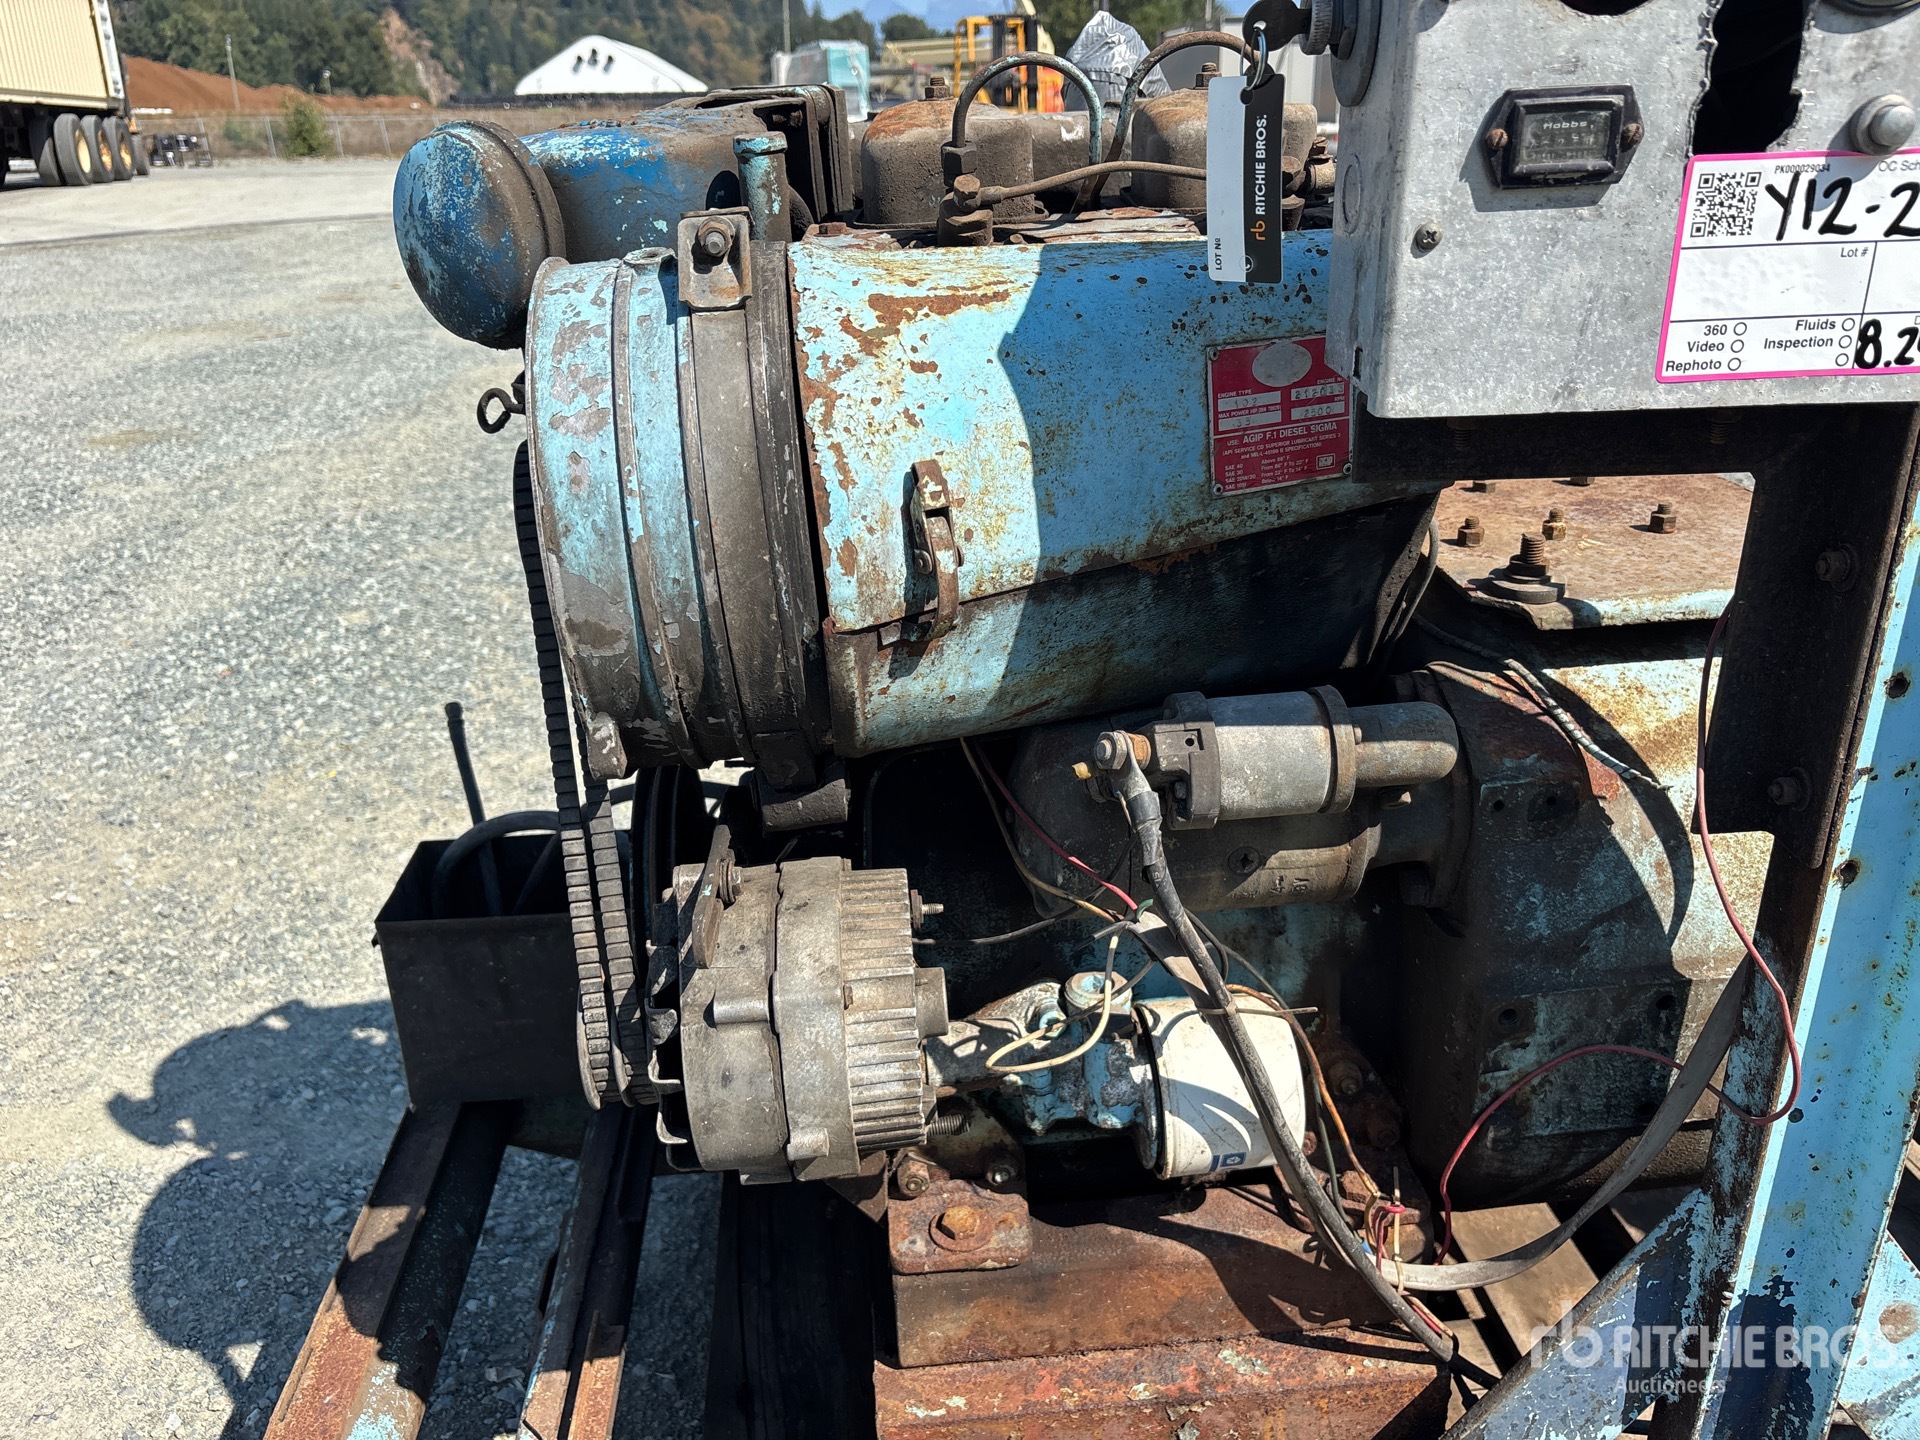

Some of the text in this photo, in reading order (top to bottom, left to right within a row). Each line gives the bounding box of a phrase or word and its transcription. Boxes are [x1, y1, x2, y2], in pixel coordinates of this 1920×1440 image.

[1543, 120, 1587, 130] Hobbs
[1878, 160, 1898, 173] OC
[1250, 114, 1267, 241] rb RITCHIE BROS.
[1840, 247, 1869, 258] Lot #
[1703, 324, 1728, 336] 360
[1795, 318, 1836, 332] Fluids
[1687, 341, 1725, 353] Video
[1764, 337, 1834, 351] Inspection
[1665, 358, 1722, 373] Rephoto
[1242, 433, 1264, 444] AGIP
[1279, 426, 1308, 438] DIESEL
[1310, 422, 1338, 434] SIGMA
[1265, 440, 1290, 449] SUPERIOR
